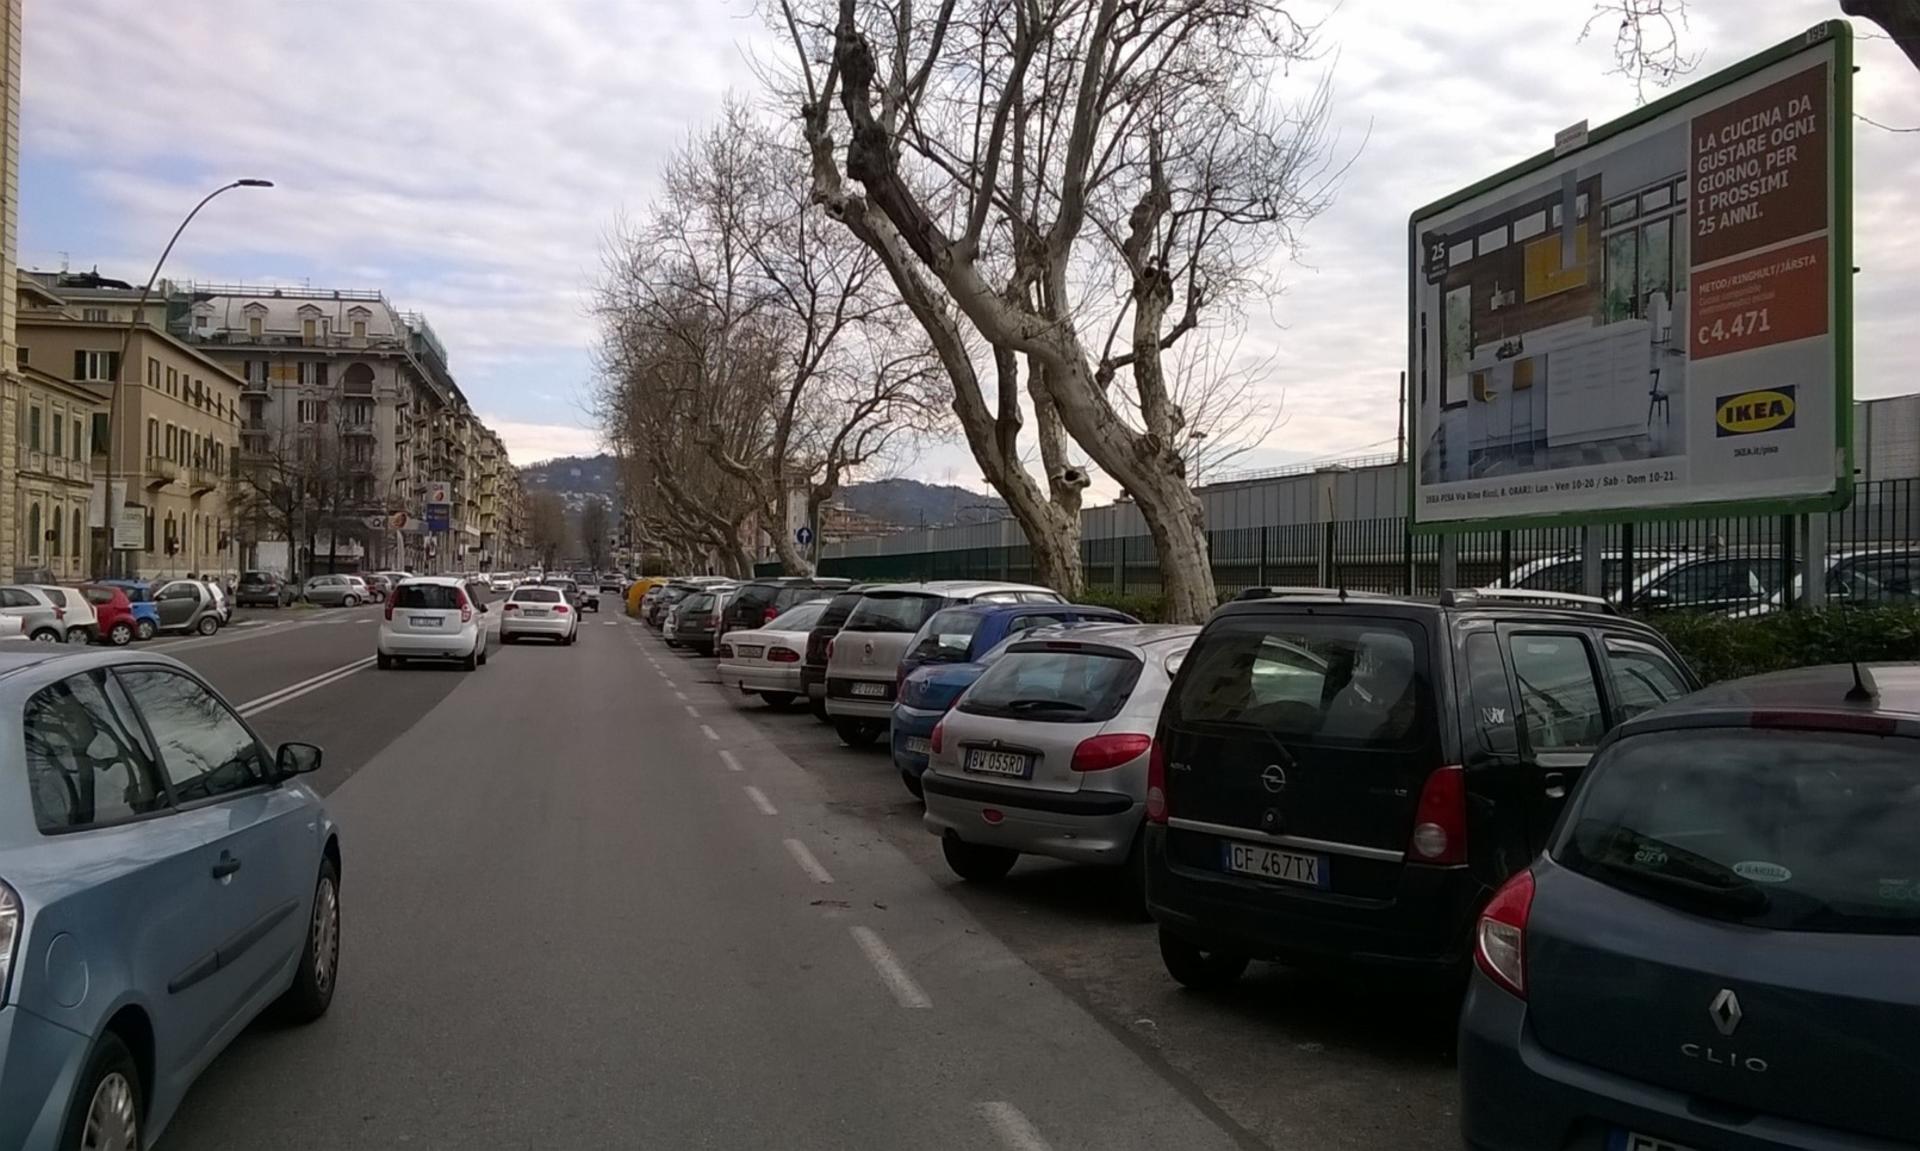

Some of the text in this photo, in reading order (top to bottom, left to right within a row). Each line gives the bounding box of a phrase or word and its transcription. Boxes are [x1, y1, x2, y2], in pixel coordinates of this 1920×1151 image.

[1698, 94, 1812, 153] LA CUCINA DA
[1698, 115, 1816, 174] GUSTARE OGNI
[1697, 145, 1798, 194] GIORNO, PER
[1698, 170, 1789, 216] I PROSSIMI
[1698, 202, 1763, 236] 25 ANNI.
[1432, 242, 1445, 262] 25
[1726, 399, 1786, 424] IKEA
[1535, 484, 1549, 493] Lun
[1555, 481, 1570, 491] Ven
[1572, 478, 1595, 489] 10-20
[1603, 476, 1619, 487] Sab
[1627, 474, 1646, 485] Dom
[972, 752, 1025, 773] BW 055RD
[1234, 847, 1317, 882] CF 467TX
[1680, 1043, 1768, 1073] CLIO
